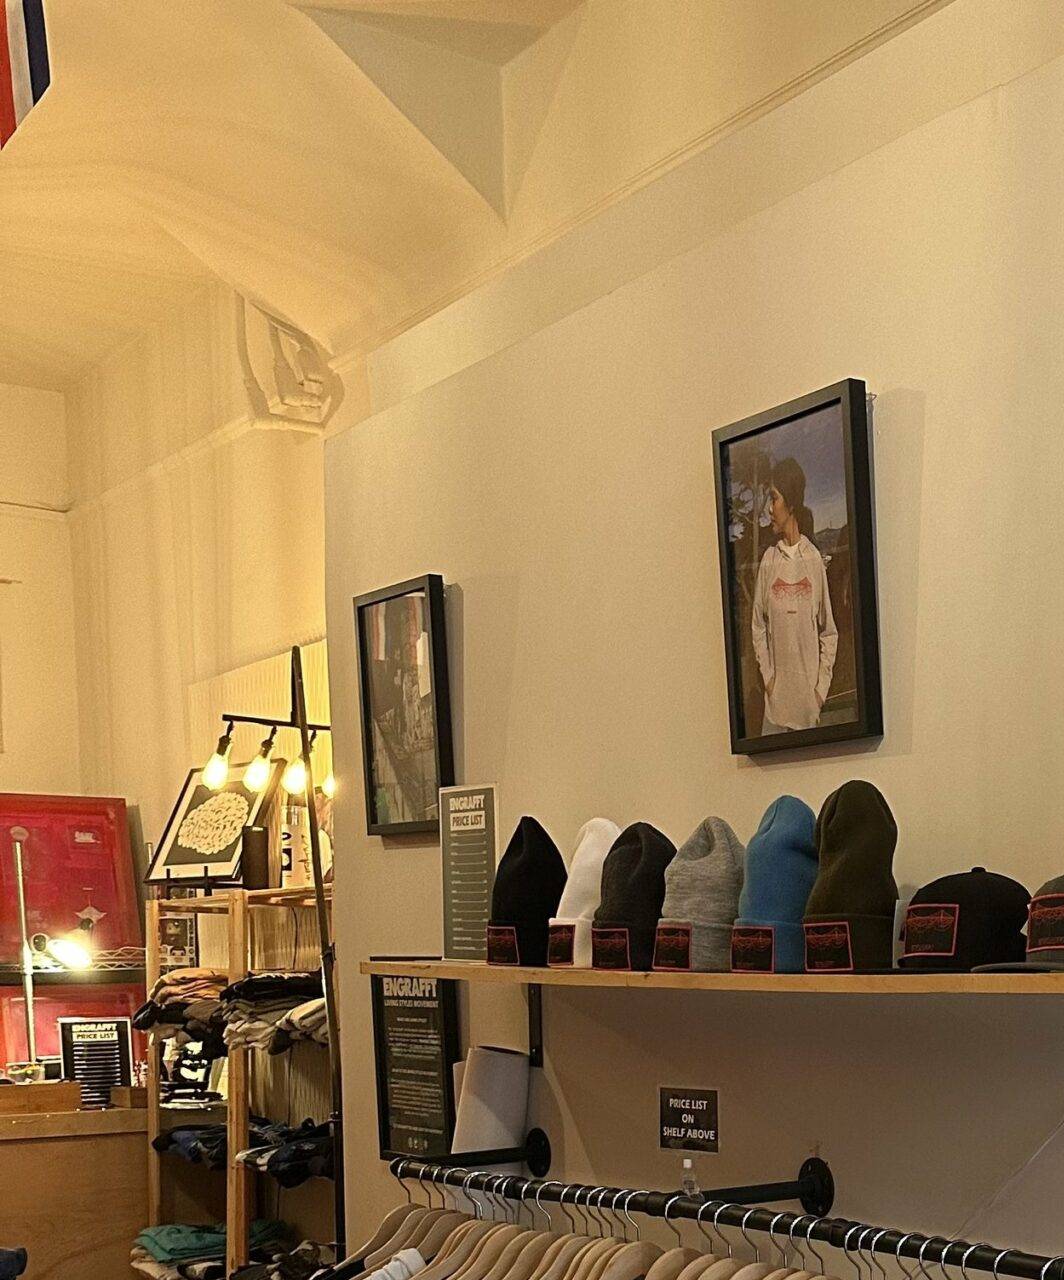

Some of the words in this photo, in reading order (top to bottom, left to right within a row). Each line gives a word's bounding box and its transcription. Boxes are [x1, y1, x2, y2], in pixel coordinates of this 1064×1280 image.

[452, 816, 469, 827] PRICE
[471, 814, 482, 826] LIST
[383, 977, 438, 997] ENGRAFFT
[669, 1098, 691, 1109] PRICE
[692, 1100, 708, 1111] LIST
[681, 1114, 694, 1124] ON
[663, 1126, 686, 1138] SHELF
[687, 1128, 715, 1140] ABOVE
